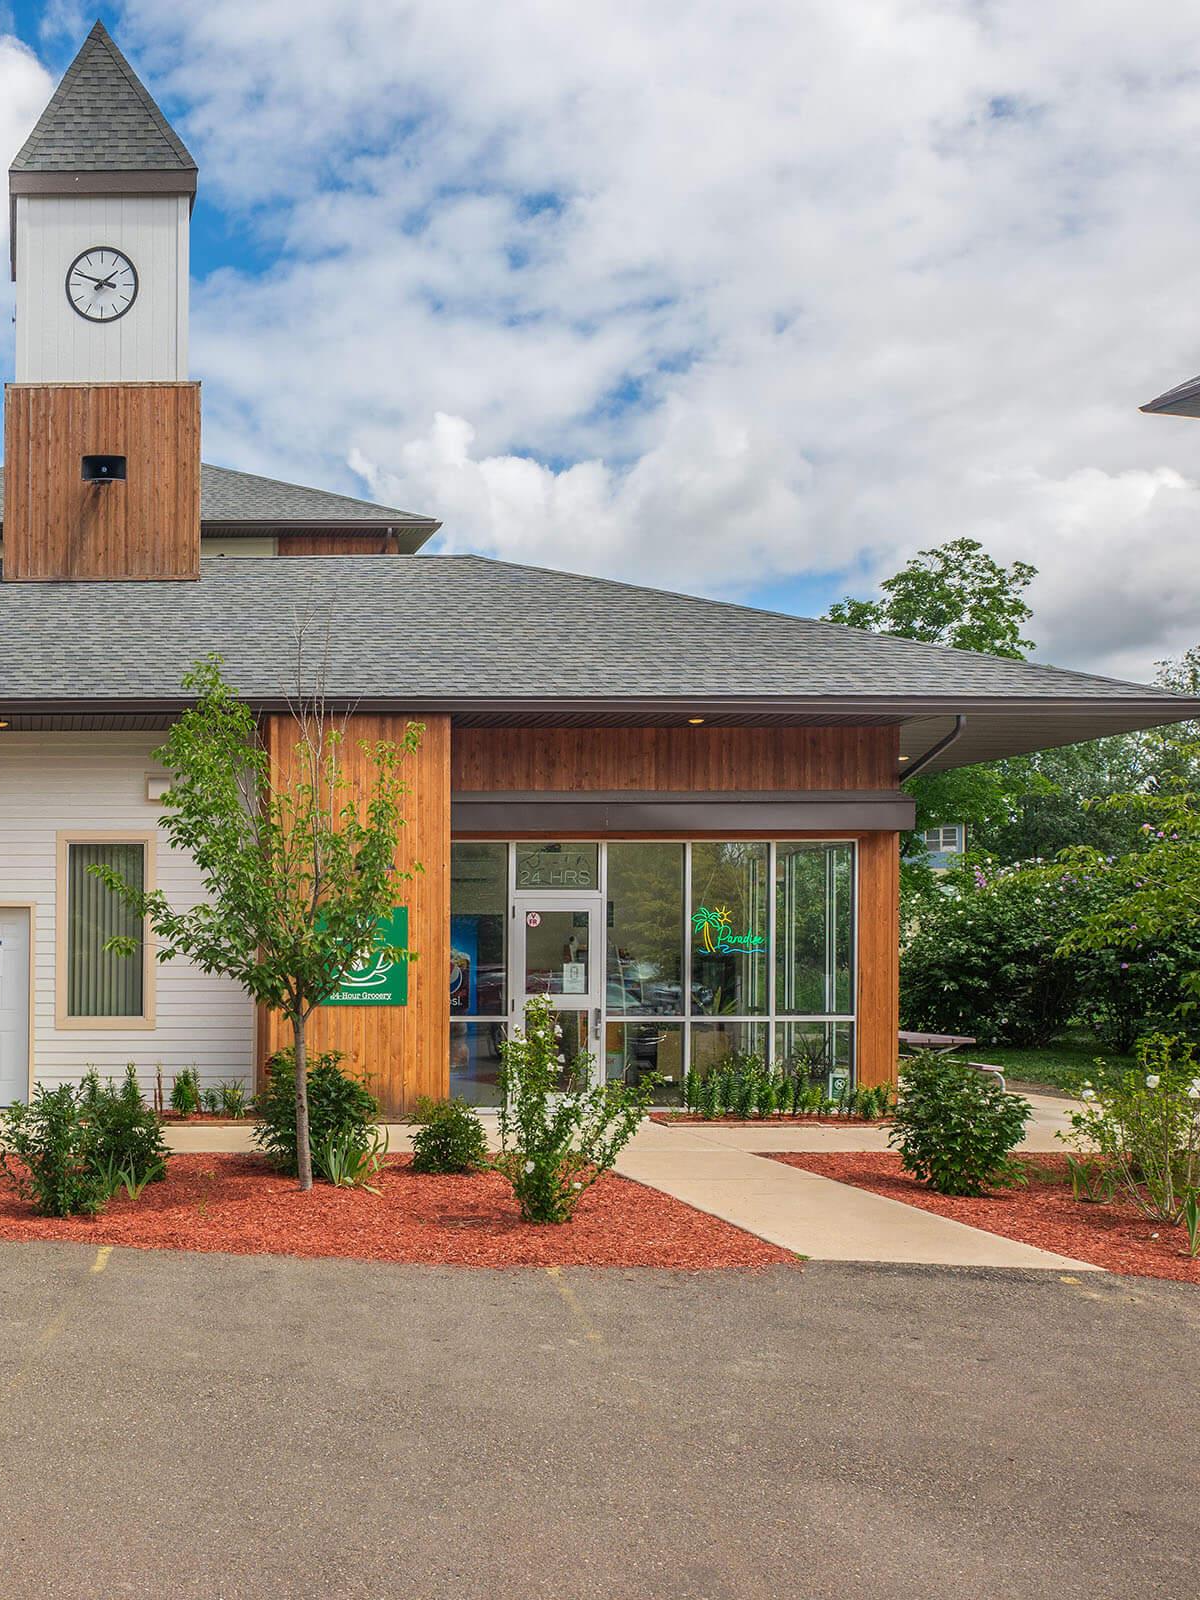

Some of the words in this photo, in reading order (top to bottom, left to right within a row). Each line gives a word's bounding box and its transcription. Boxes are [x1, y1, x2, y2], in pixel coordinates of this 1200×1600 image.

[519, 870, 541, 885] 24
[550, 870, 591, 885] HRS
[718, 925, 765, 949] Paradise
[361, 992, 392, 1001] Grocery
